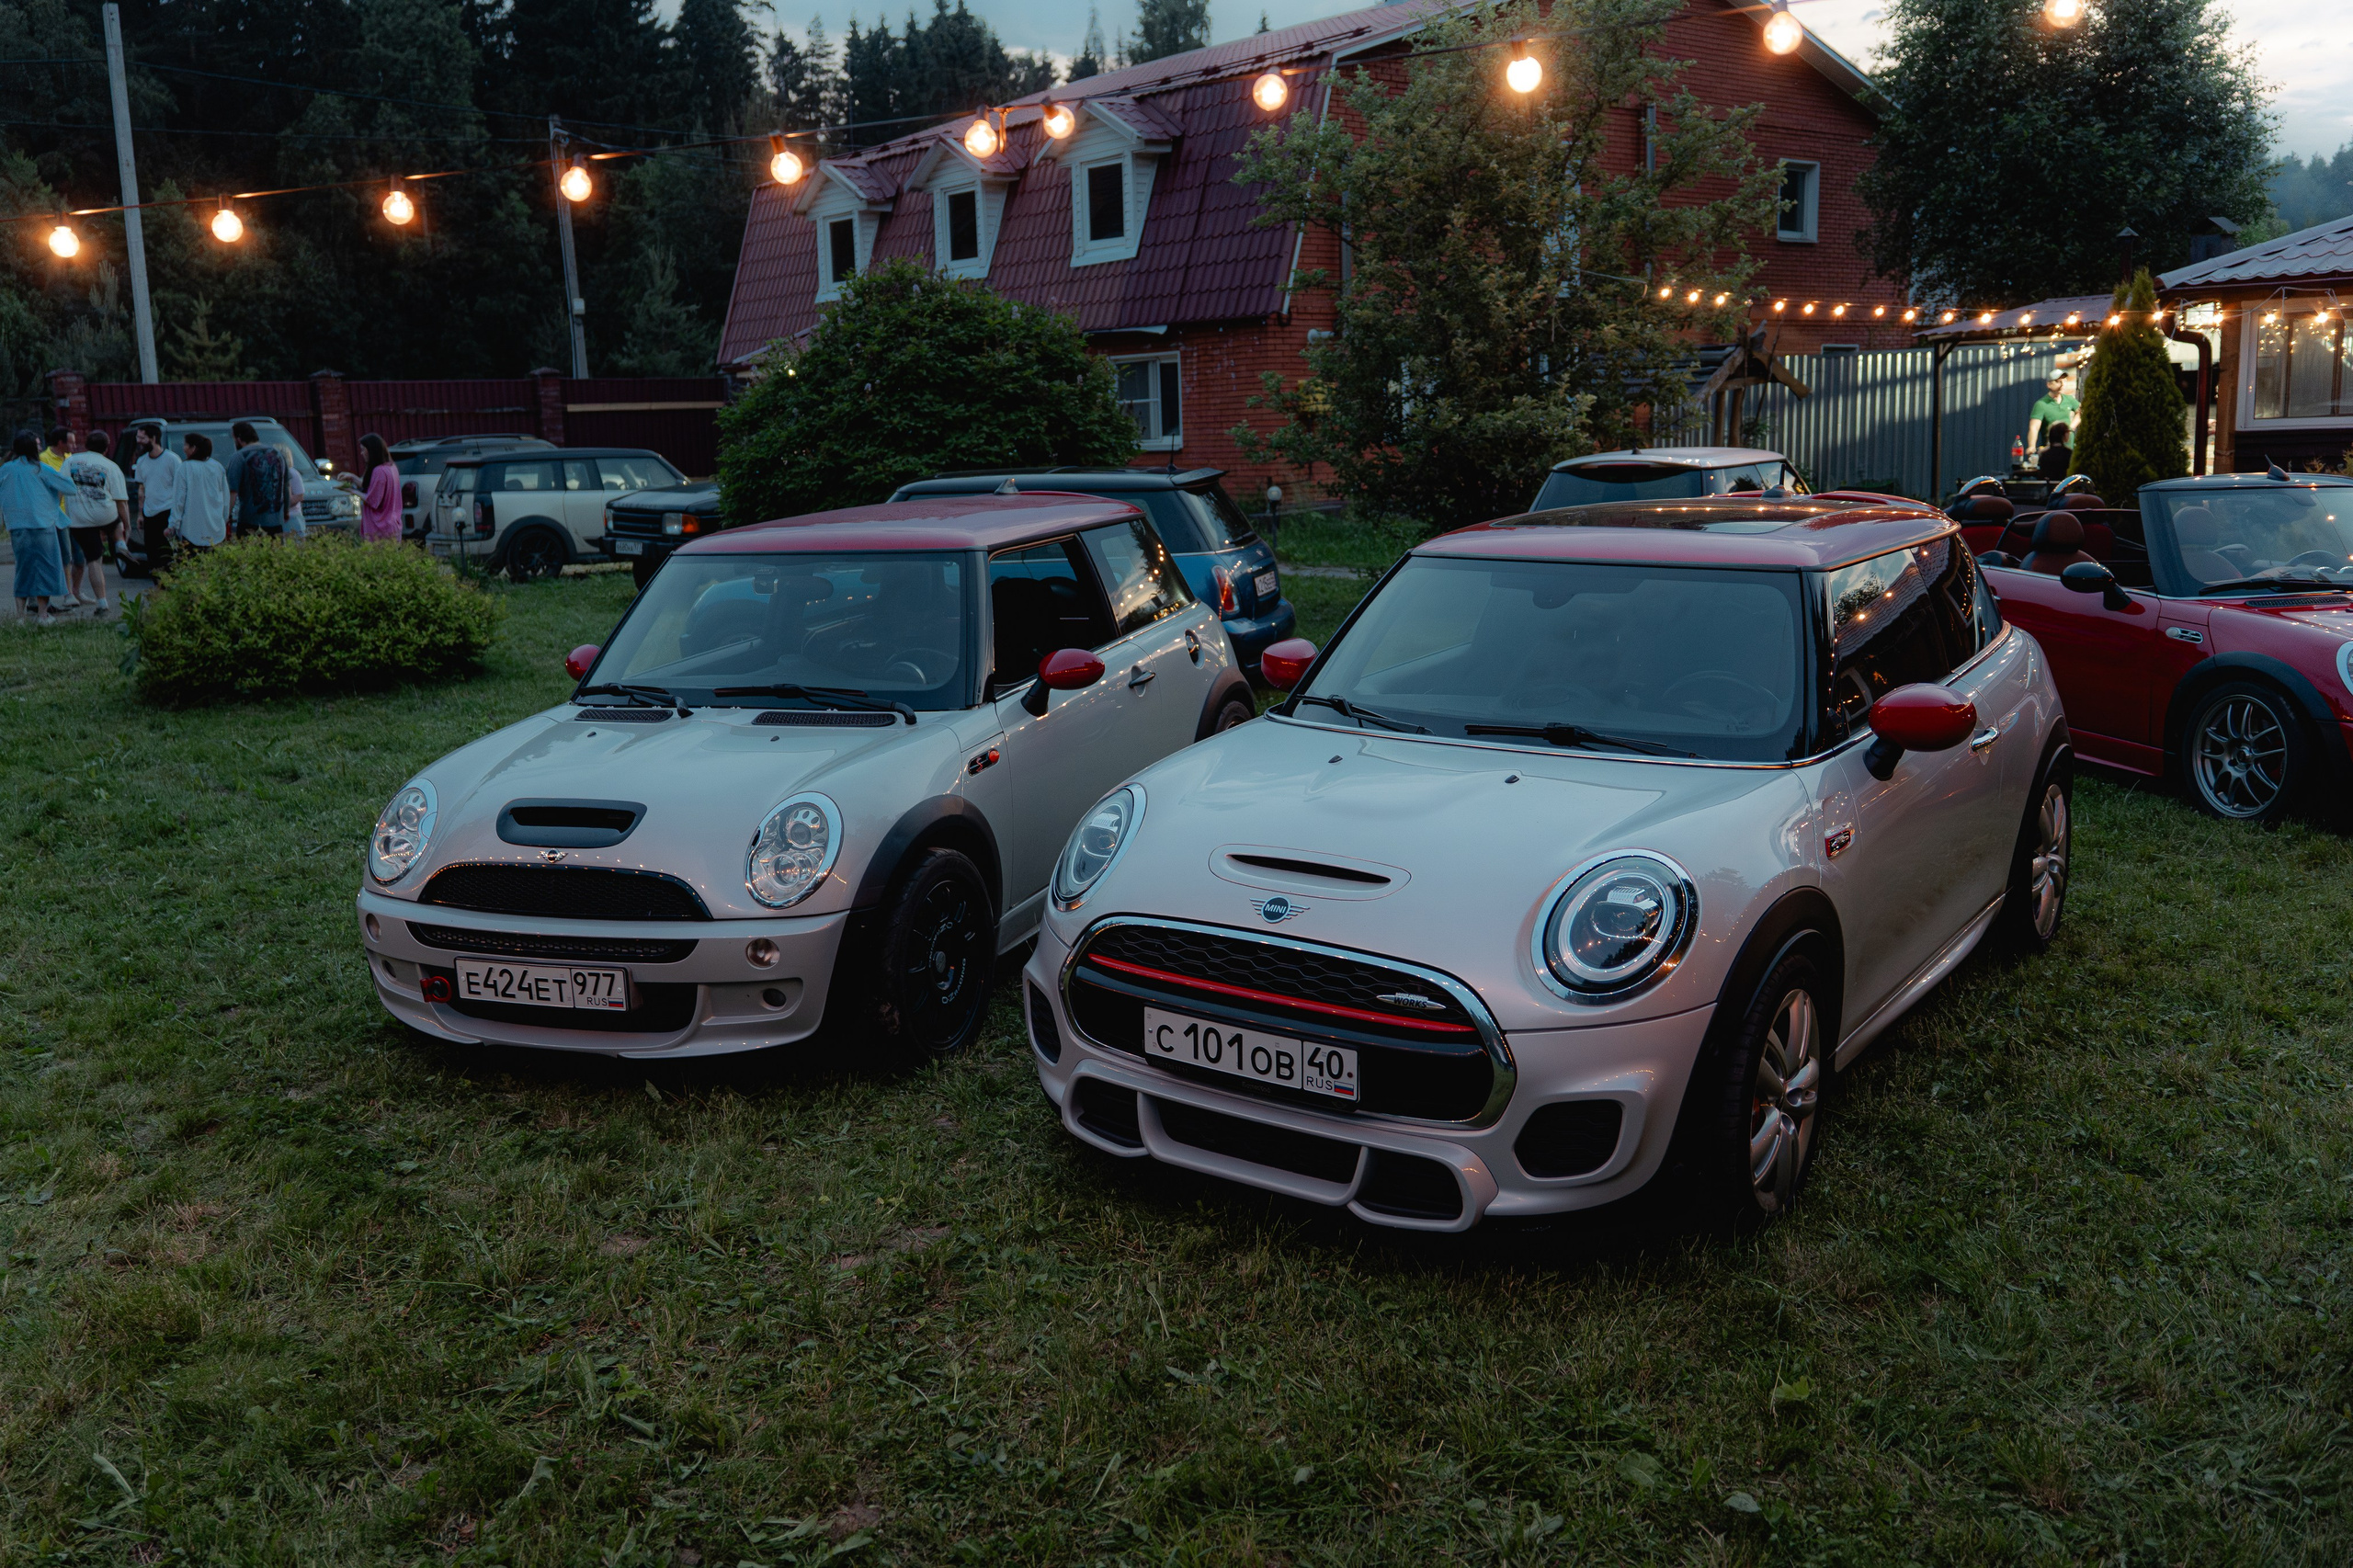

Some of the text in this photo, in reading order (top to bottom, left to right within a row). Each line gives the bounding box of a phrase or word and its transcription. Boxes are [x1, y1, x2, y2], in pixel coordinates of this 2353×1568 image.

[1265, 904, 1287, 914] MINI
[573, 971, 616, 996] 977
[586, 996, 608, 1006] RUS
[1394, 996, 1427, 1008] WORKS
[1307, 1047, 1344, 1079] 40
[1306, 1076, 1333, 1091] RUS
